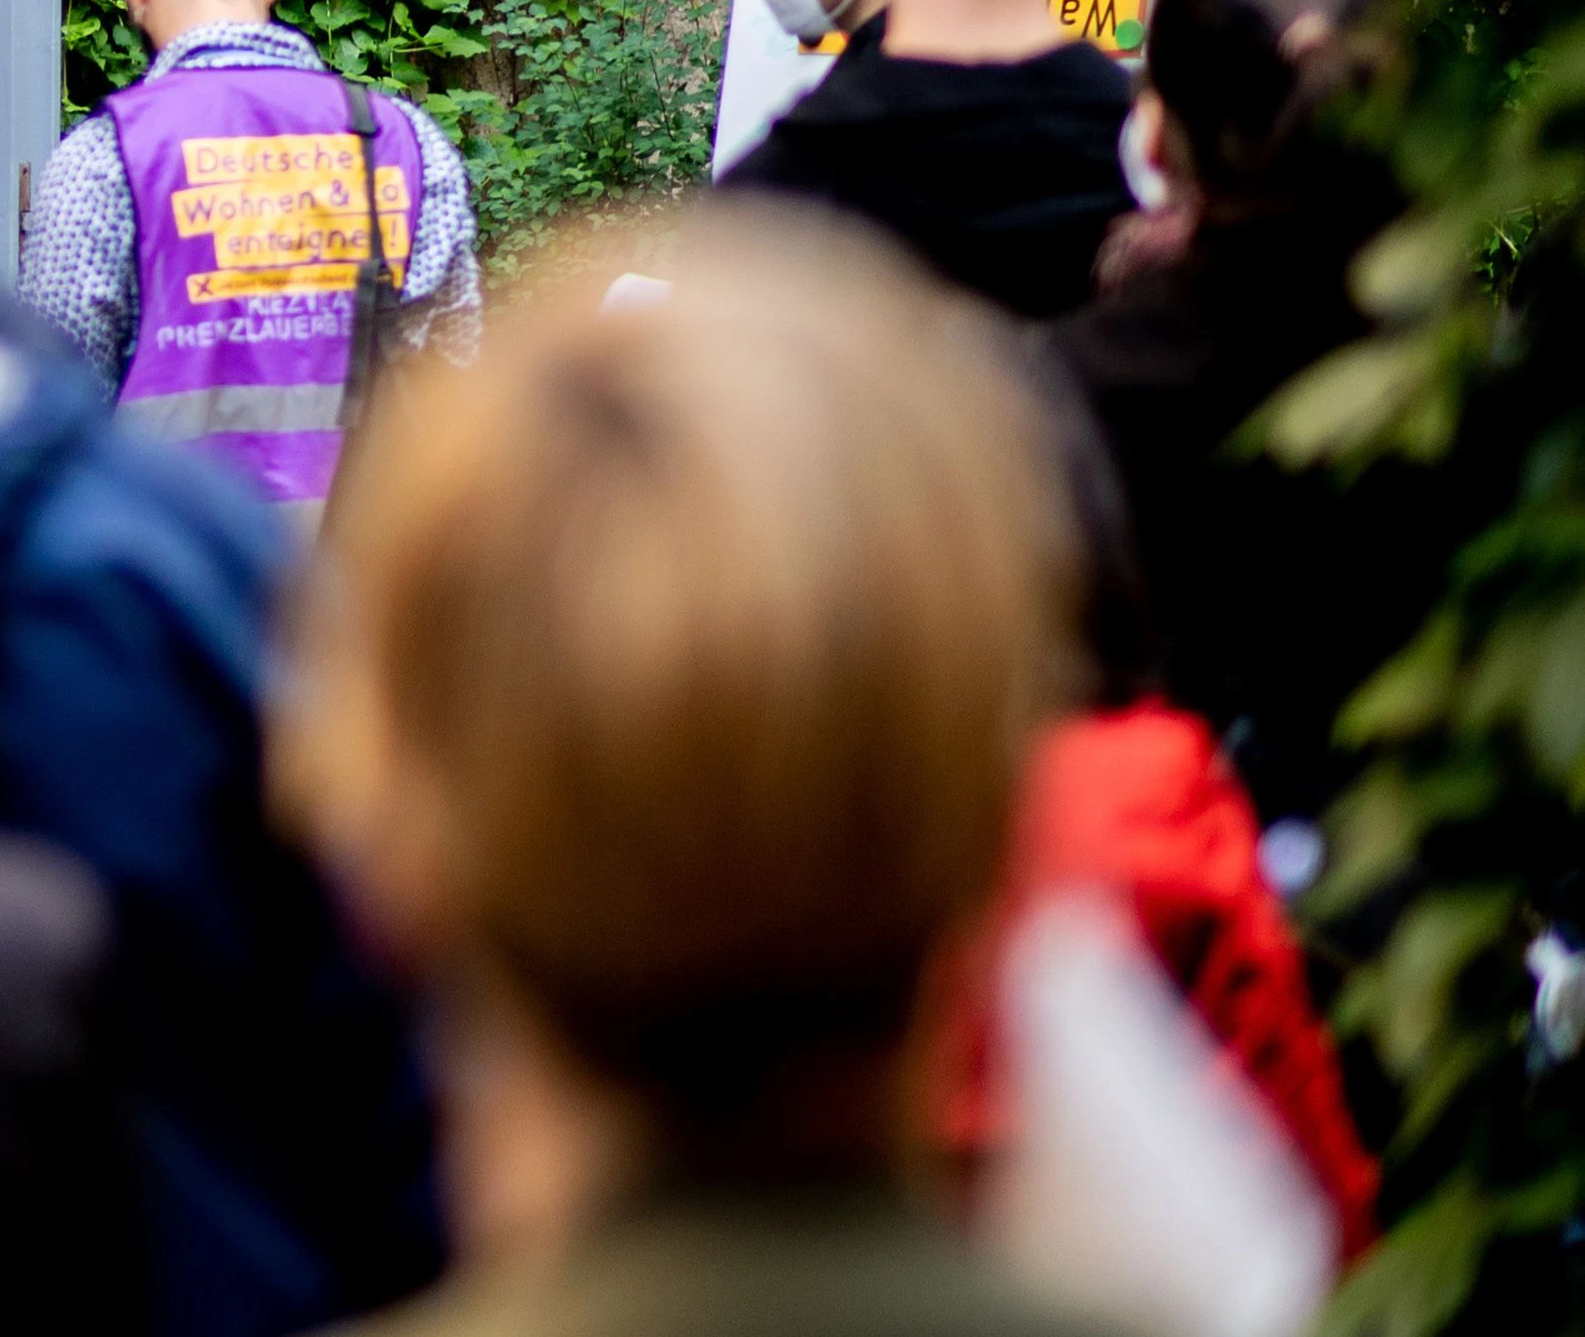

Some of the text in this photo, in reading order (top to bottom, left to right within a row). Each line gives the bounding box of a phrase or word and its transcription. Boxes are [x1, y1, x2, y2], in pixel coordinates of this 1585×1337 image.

[195, 142, 355, 174] Deutsche
[183, 189, 317, 225] Wohnen
[329, 178, 350, 207] &
